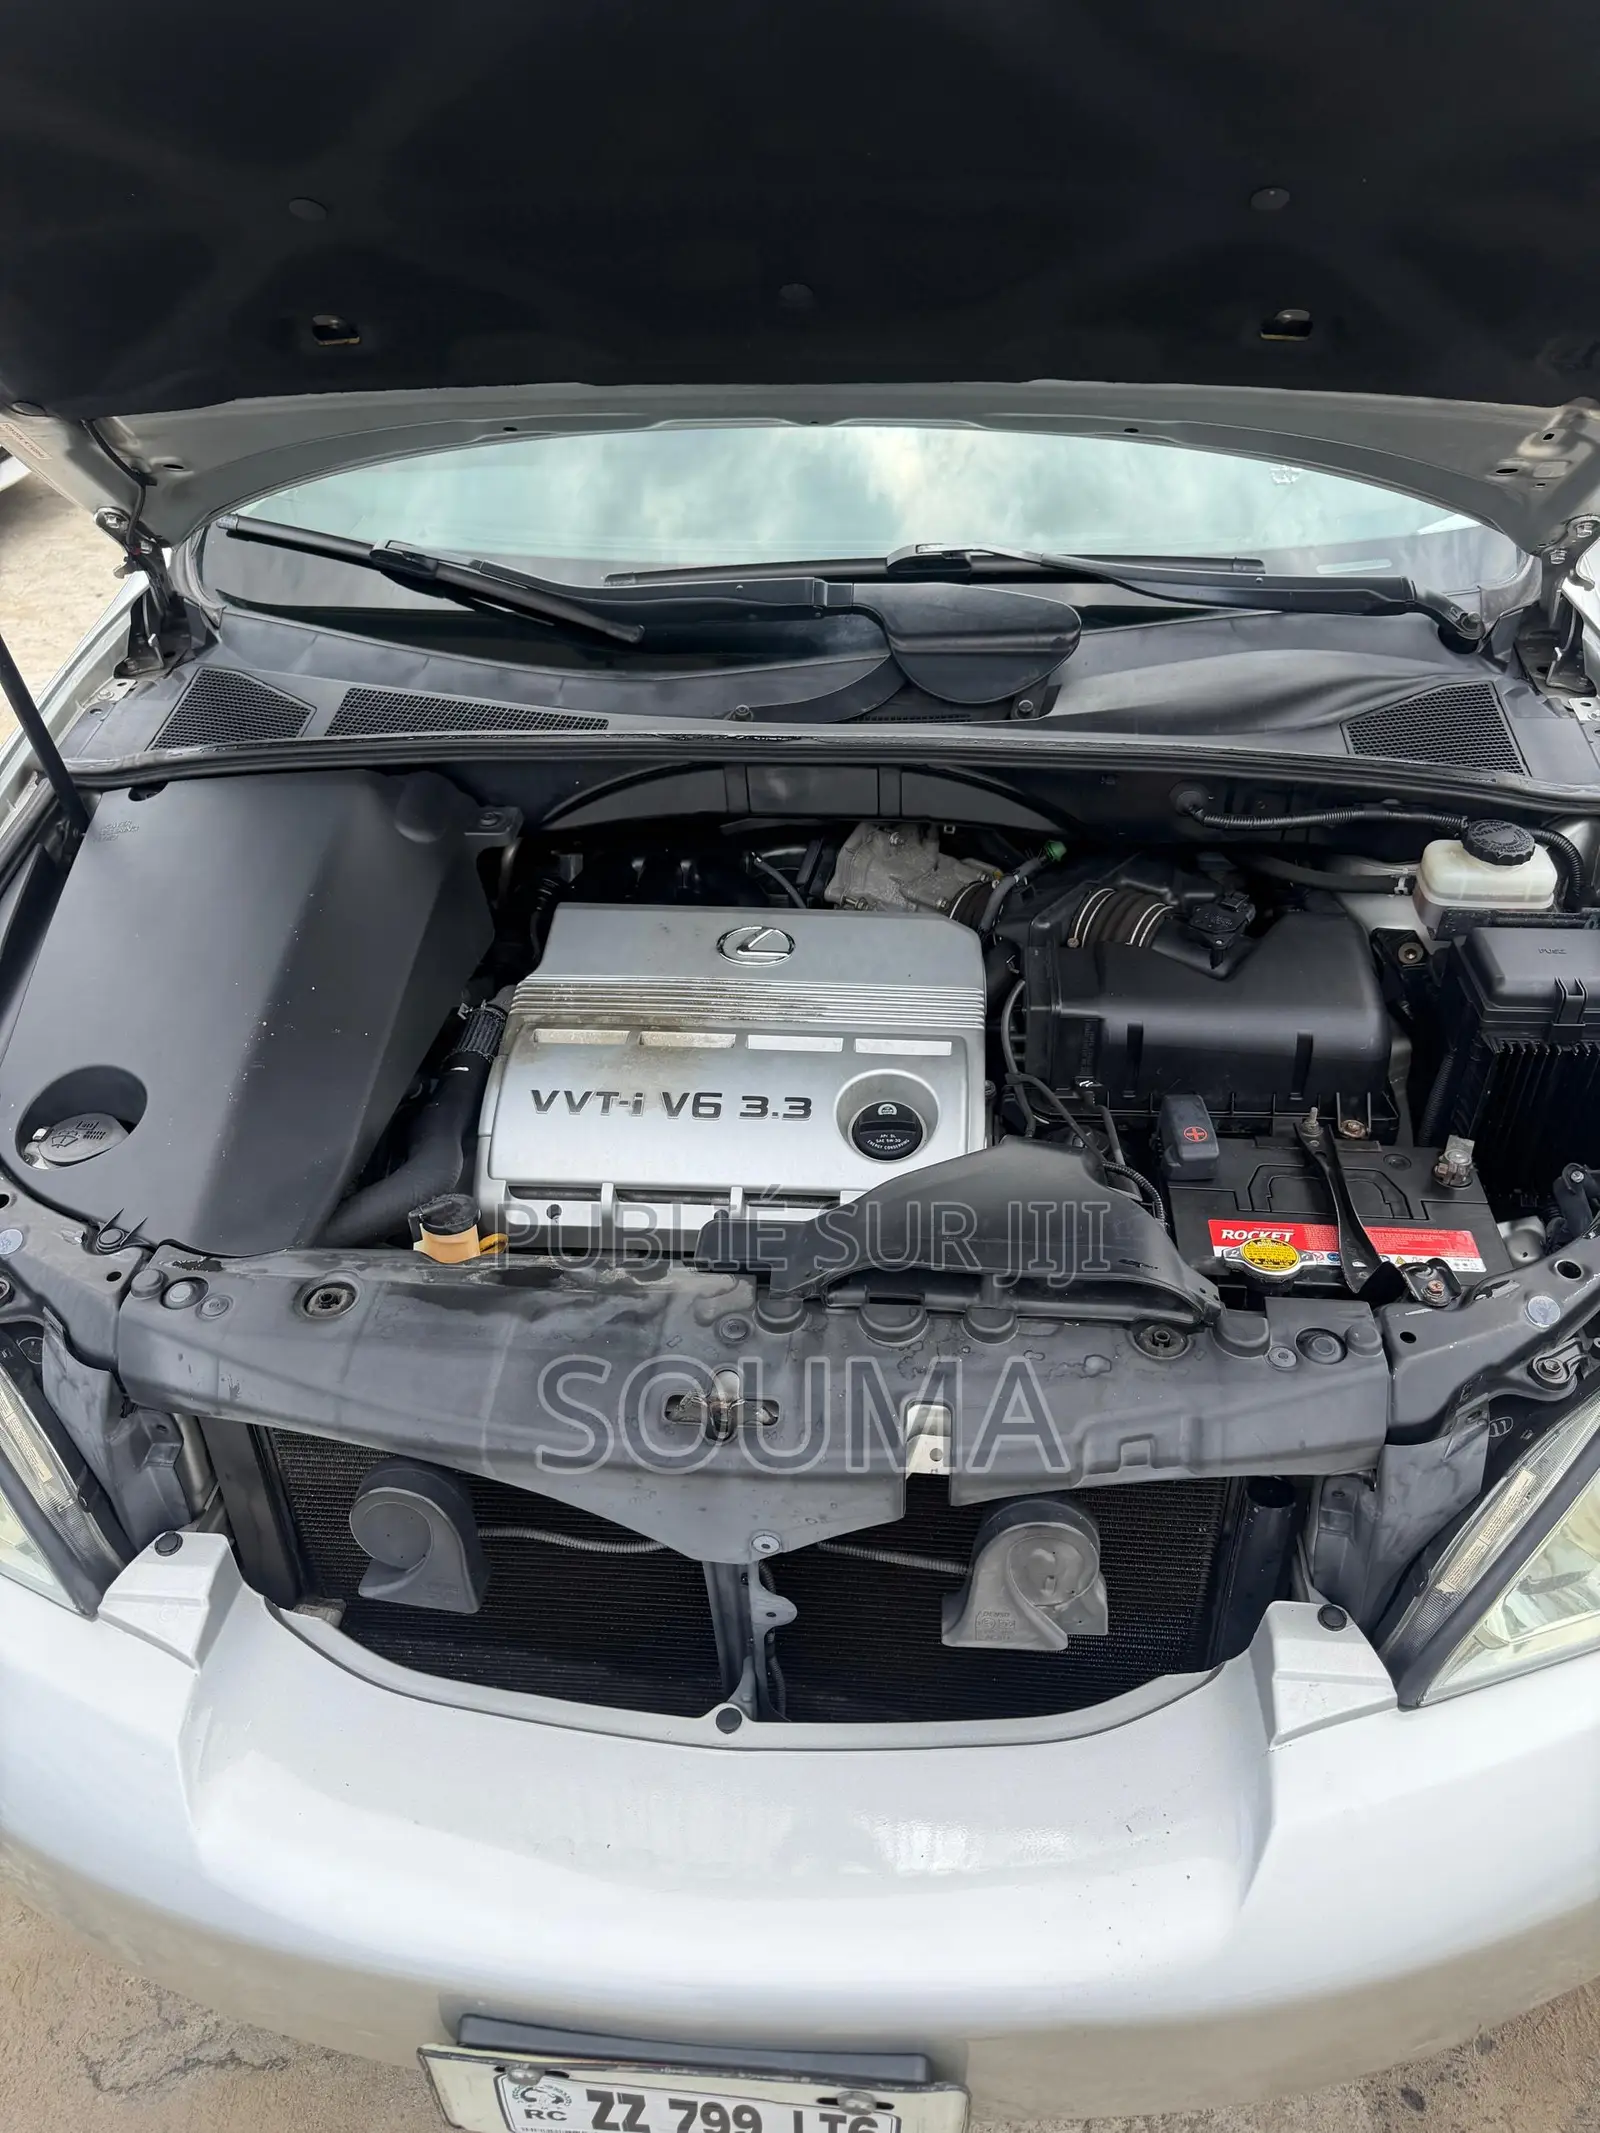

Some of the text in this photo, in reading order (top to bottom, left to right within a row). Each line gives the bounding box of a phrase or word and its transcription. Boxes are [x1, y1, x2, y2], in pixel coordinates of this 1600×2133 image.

[531, 1089, 813, 1122] VVT-i V6 3.3
[1221, 1229, 1295, 1243] ROCKET
[524, 2109, 568, 2121] RC
[586, 2088, 651, 2132] ZZ
[668, 2097, 763, 2133] 799
